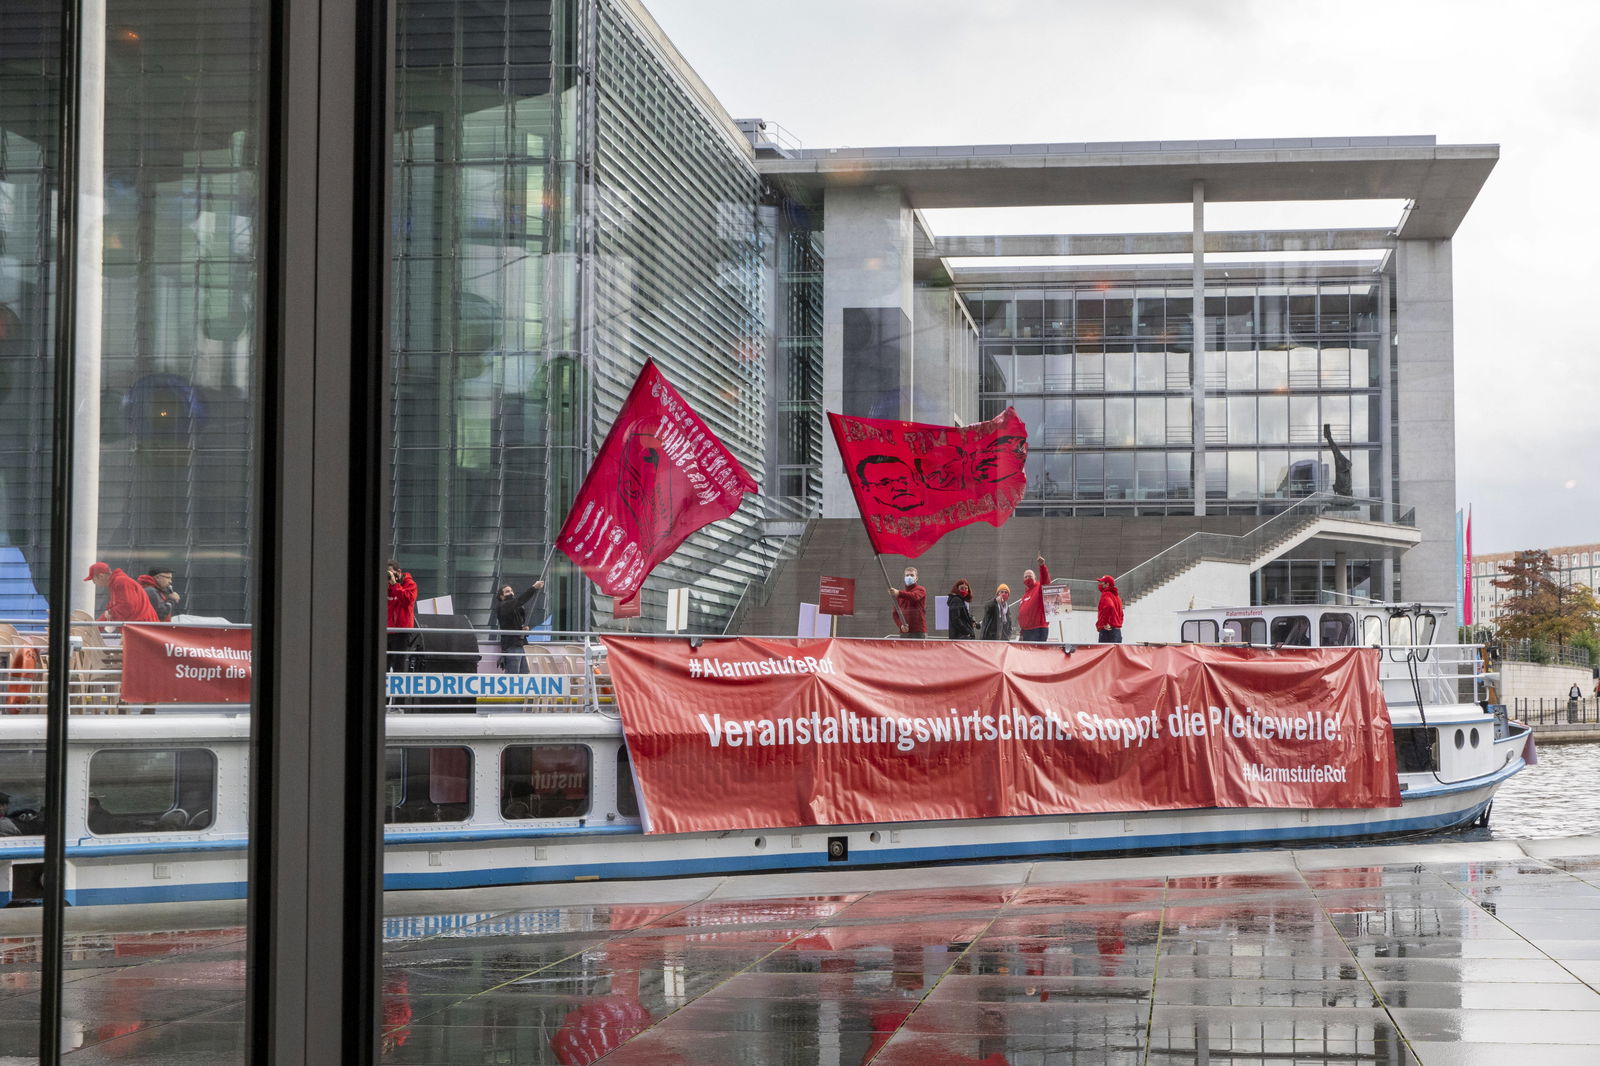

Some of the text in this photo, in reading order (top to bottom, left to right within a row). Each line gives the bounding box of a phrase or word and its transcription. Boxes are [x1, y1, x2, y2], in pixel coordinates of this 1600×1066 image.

[175, 664, 222, 680] Stoppt
[226, 665, 246, 678] die
[689, 656, 836, 678] #AlarmstufeRot
[699, 704, 1342, 751] Veranstaltungswirtschaft: Stoppt die Pleitewelle!
[1243, 763, 1346, 783] #AlarmstufeRot
